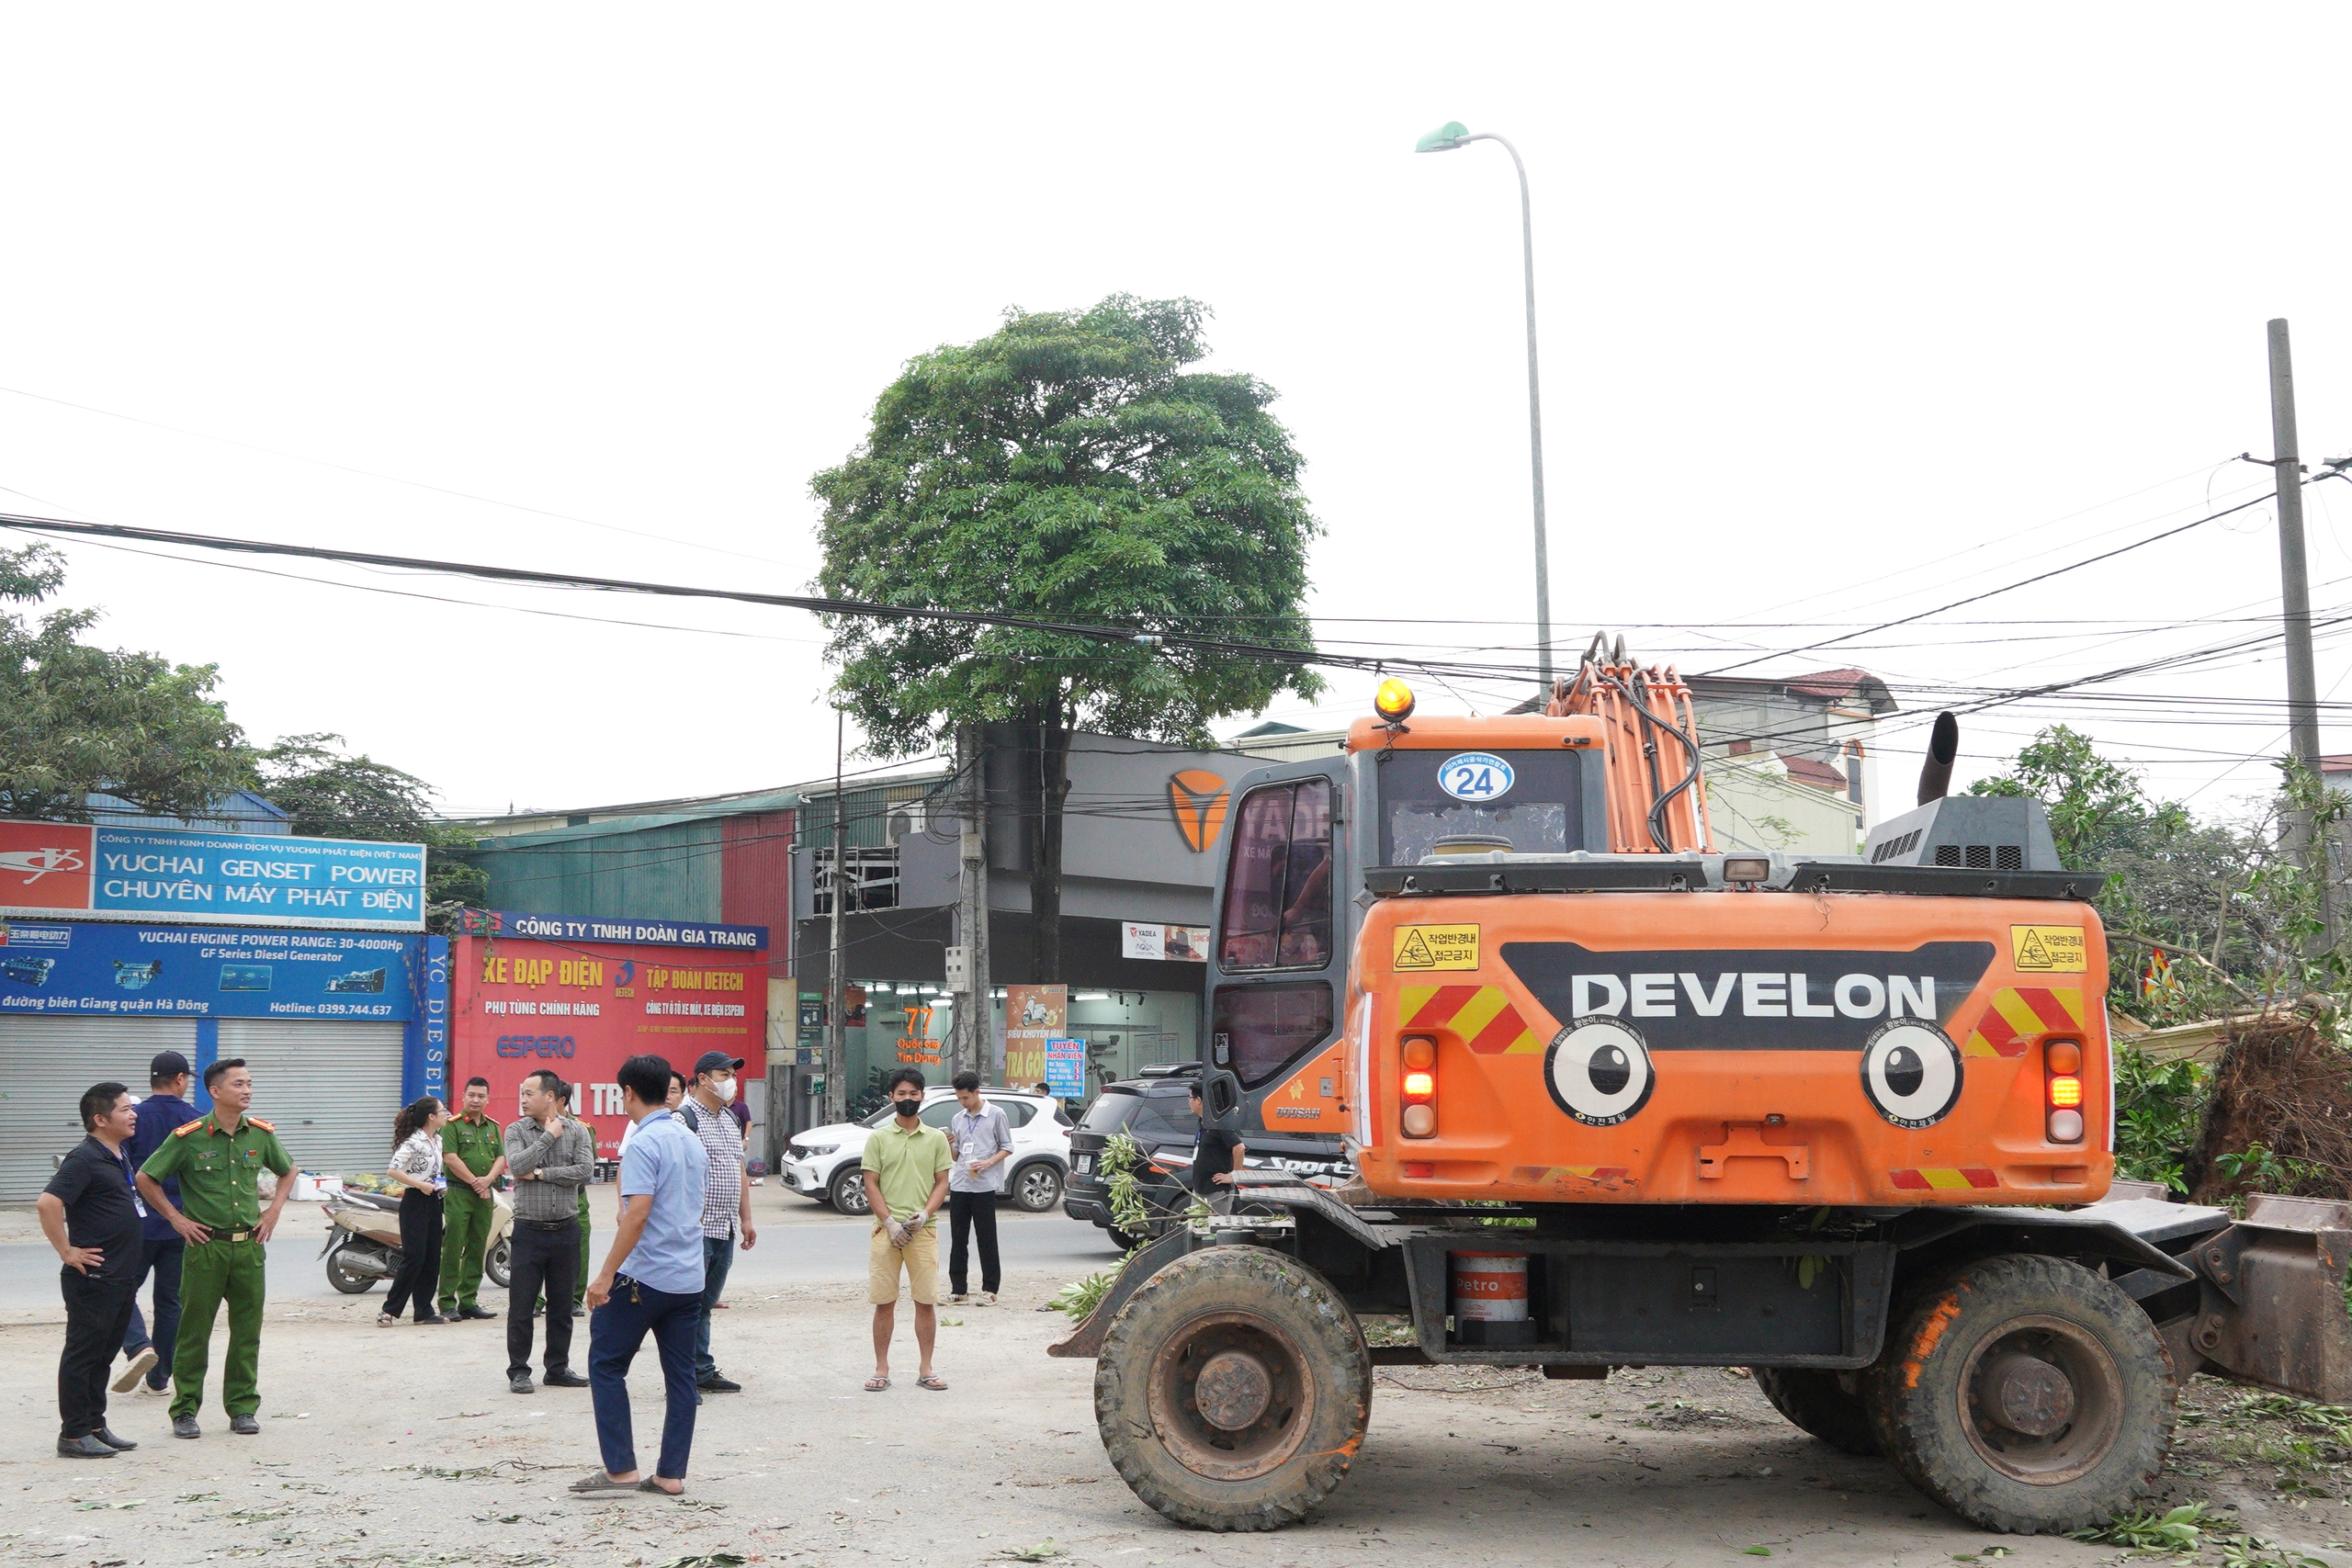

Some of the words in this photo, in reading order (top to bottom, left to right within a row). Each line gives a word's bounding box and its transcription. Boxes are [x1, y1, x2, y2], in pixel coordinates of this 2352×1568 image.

[1456, 768, 1494, 795] 24
[99, 834, 130, 844] CÔNG
[147, 838, 177, 846] TNHH
[179, 839, 205, 847] KINH
[207, 840, 243, 850] DOANH
[244, 842, 268, 852] DỊCH
[270, 844, 284, 854] VỤ
[285, 846, 321, 855] YUCHAI
[322, 846, 347, 856] PHÁT
[349, 849, 372, 858] ĐIỆN
[374, 850, 397, 860] (VIỆT
[398, 852, 422, 861] NAM)
[1257, 845, 1272, 859] MÁ
[104, 852, 204, 875] YUCHAI
[220, 859, 316, 881] GENSET
[331, 865, 417, 886] POWER
[104, 878, 212, 901] CHUYÊN
[225, 882, 277, 904] MÁY
[288, 886, 352, 907] PHÁT
[361, 888, 413, 913] ĐIỆN
[515, 916, 562, 936] CÔNG
[566, 922, 585, 937] TY
[592, 923, 631, 940] TNHH
[635, 923, 677, 942] ĐOÀN
[681, 930, 706, 943] GIA
[709, 931, 756, 946] TRANG
[1429, 933, 1476, 944] 작업반경내
[138, 931, 187, 943] YUCHAI
[190, 932, 239, 945] ENGINE
[241, 934, 289, 947] POWER
[290, 936, 336, 948] RANGE:
[339, 939, 403, 952] 30-4000Hp
[2044, 935, 2084, 947] 작업반경내
[201, 948, 216, 958] GF
[219, 949, 253, 960] Series
[254, 950, 288, 961] Diesel
[289, 952, 343, 962] Generator
[1434, 950, 1473, 961] 접근금지
[2051, 952, 2083, 964] 접근금지
[429, 954, 447, 983] YC
[481, 957, 507, 983] XE
[514, 958, 553, 989] ĐẠP
[559, 955, 603, 990] ĐIỆN
[646, 965, 669, 992] TẬP
[672, 967, 702, 990] ĐOÀN
[704, 971, 744, 991] DETECH
[2, 995, 45, 1010] đường
[48, 996, 77, 1008] biên
[80, 998, 118, 1011] Giang
[120, 998, 153, 1012] quận
[155, 998, 174, 1010] Hà
[176, 999, 209, 1013] Đông
[1571, 972, 1938, 1021] DEVELON
[269, 1001, 315, 1014] Hotline:
[318, 1003, 392, 1015] 0399.744.637
[484, 1000, 507, 1017] PHỤ
[509, 998, 537, 1015] TÙNG
[538, 999, 571, 1016] CHÍNH
[904, 1008, 933, 1035] 77
[425, 998, 445, 1097] DIESEL
[496, 1035, 576, 1057] ESPERO
[897, 1037, 922, 1049] Quốc
[923, 1037, 940, 1049] Gia
[1051, 1039, 1080, 1050] TUYỂN
[1006, 1042, 1023, 1077] TRẢ
[1047, 1051, 1066, 1060] NHÂN
[1067, 1051, 1083, 1060] VIÊN
[1275, 1106, 1321, 1120] DOOSAN
[1587, 1112, 1627, 1126] 안전제일
[1456, 1277, 1498, 1292] Petro
